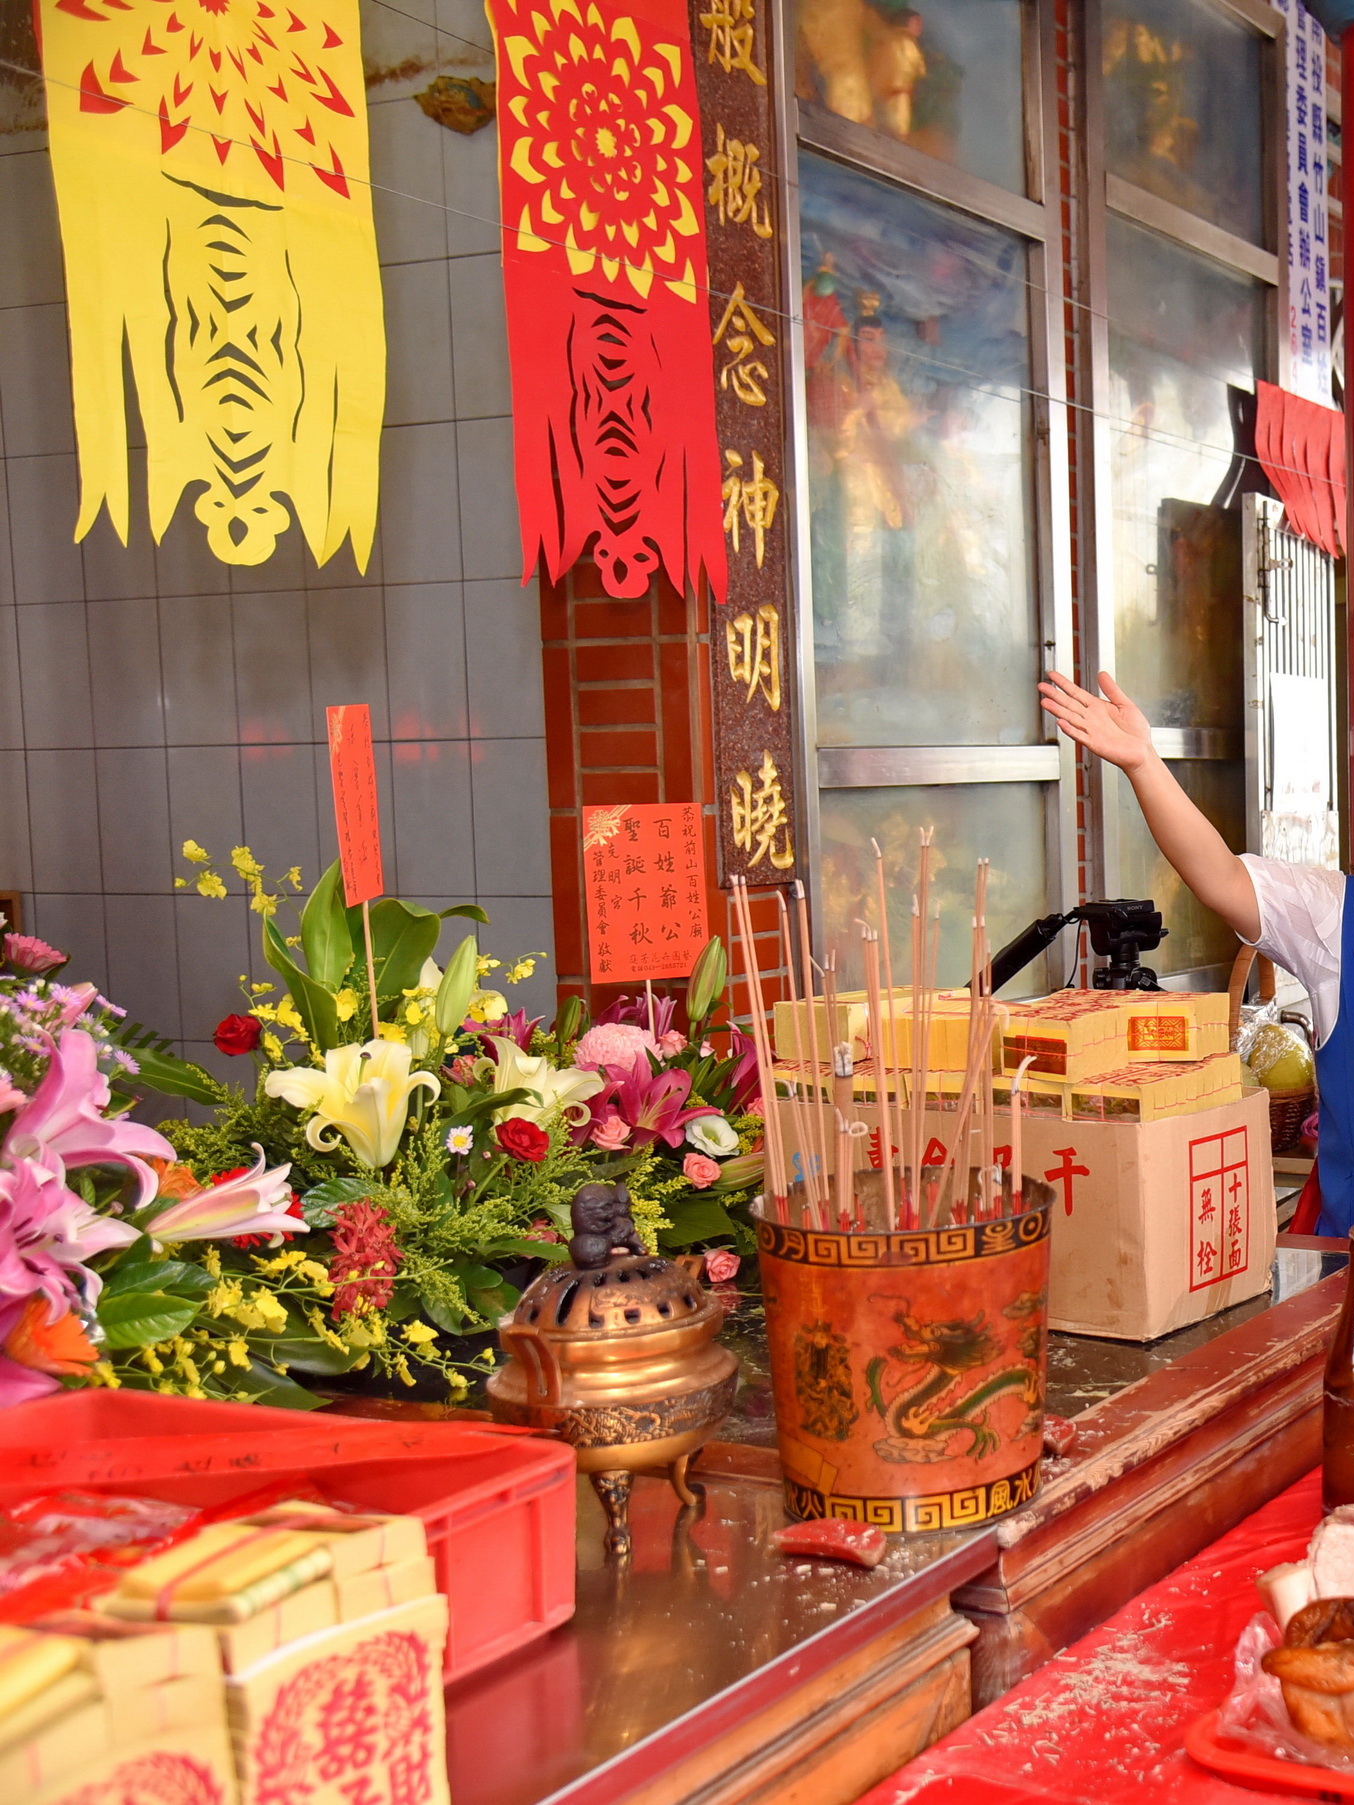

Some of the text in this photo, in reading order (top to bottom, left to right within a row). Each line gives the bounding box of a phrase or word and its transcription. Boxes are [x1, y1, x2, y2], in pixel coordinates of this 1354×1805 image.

[622, 816, 654, 946] 聖誕千秋
[652, 817, 682, 942] 百姓爺公
